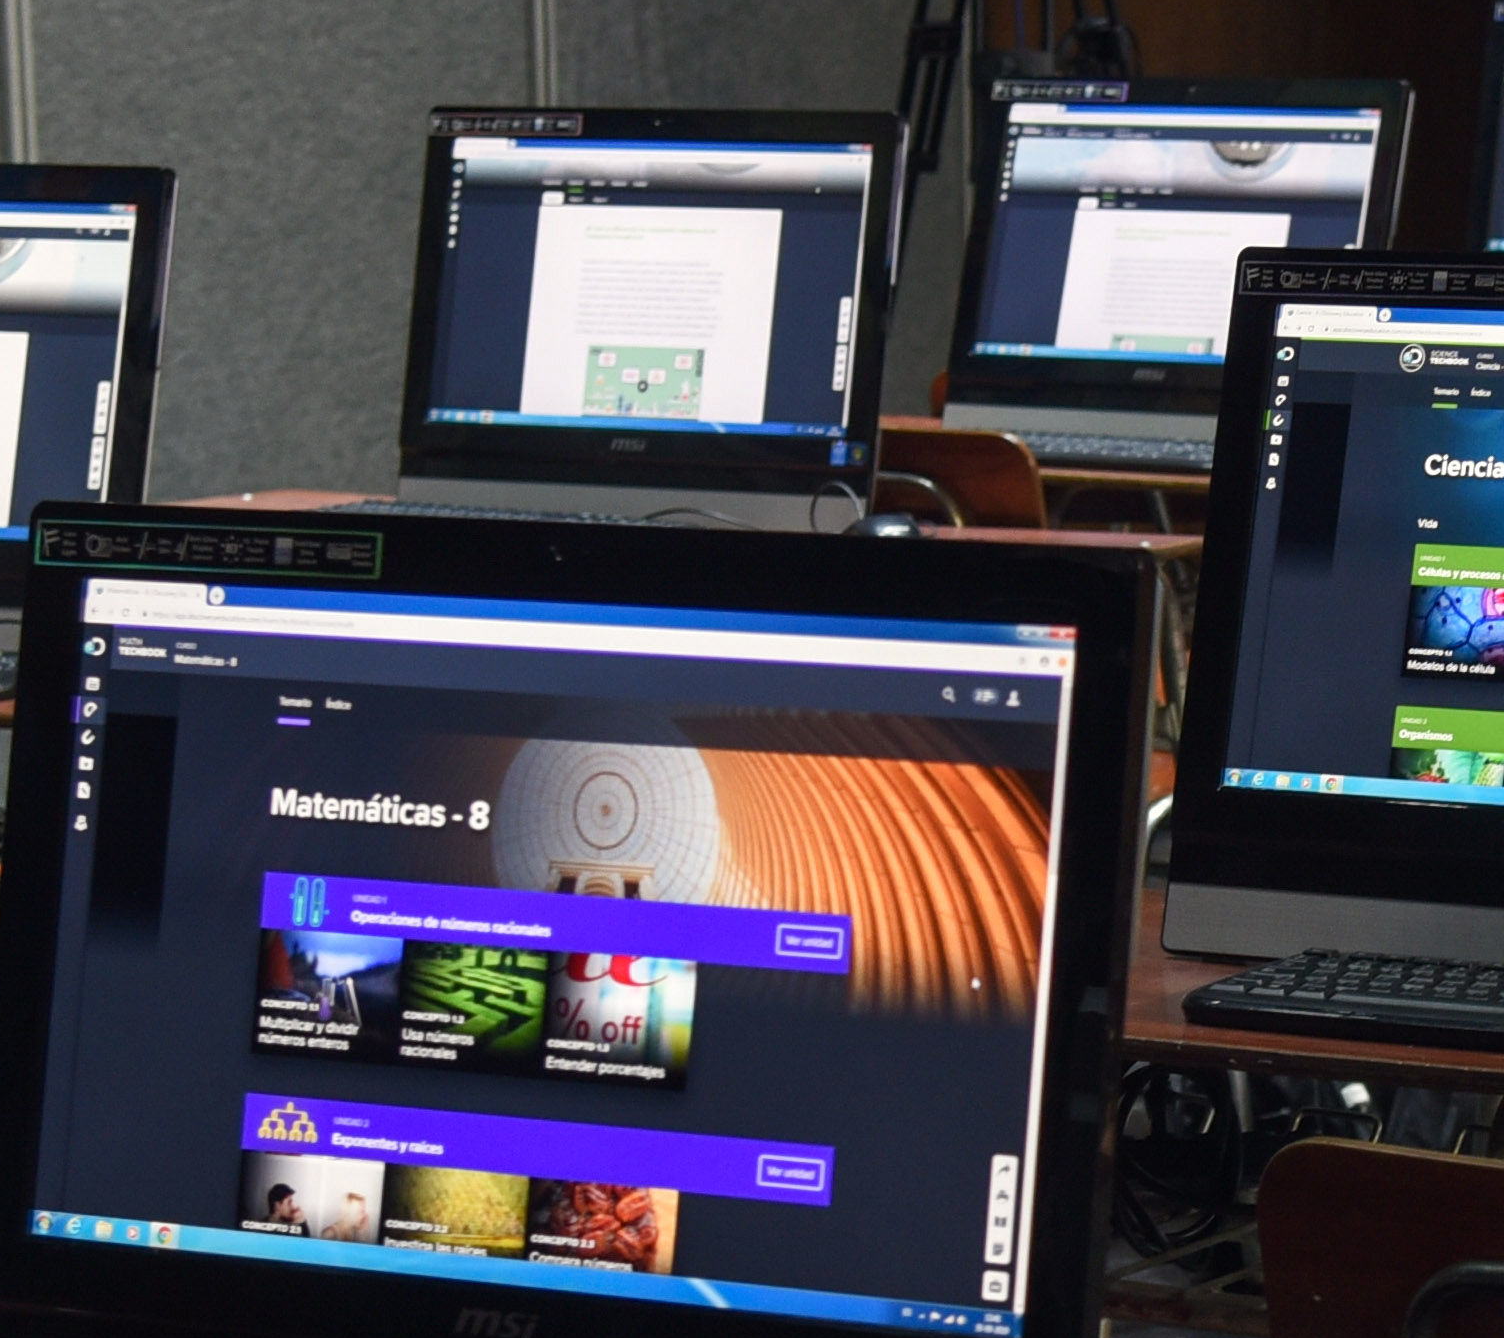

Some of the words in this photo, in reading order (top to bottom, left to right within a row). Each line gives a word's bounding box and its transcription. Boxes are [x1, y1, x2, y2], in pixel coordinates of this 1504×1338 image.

[1475, 362, 1500, 371] Ciencia
[1434, 386, 1460, 396] Temario
[1470, 386, 1491, 397] Índice
[1417, 518, 1438, 529] Vida
[1418, 565, 1451, 580] Células
[1452, 570, 1459, 581] y
[1460, 570, 1501, 582] procesos
[174, 652, 225, 667] Matemáticas
[1408, 648, 1442, 657] CONCEPTO
[1407, 660, 1445, 672] Modelos
[1446, 662, 1458, 673] de
[1459, 663, 1468, 673] la
[1469, 663, 1496, 675] célula
[279, 695, 313, 708] Temario
[325, 696, 352, 710] Índice
[1399, 729, 1453, 744] Organismos
[270, 786, 447, 828] Matemáticas
[468, 800, 490, 831] 8
[350, 909, 422, 929] Operaciones
[424, 915, 439, 929] de
[440, 916, 490, 932] números
[492, 920, 551, 938] racionales
[261, 998, 307, 1011] CONCEPTO
[403, 1010, 450, 1023] CONCEPTO
[259, 1015, 314, 1033] Multiplicar
[315, 1023, 323, 1035] y
[325, 1022, 360, 1037] dividir
[601, 1014, 642, 1045] off
[258, 1032, 305, 1047] números
[308, 1035, 349, 1050] enteros
[402, 1027, 423, 1042] Usa
[425, 1029, 474, 1047] números
[546, 1038, 596, 1052] CONCEPTO
[400, 1045, 457, 1061] racionales
[545, 1055, 597, 1074] Entender
[598, 1059, 665, 1080] porcentajes
[331, 1131, 397, 1152] Exponentes
[399, 1140, 408, 1155] y
[409, 1139, 443, 1156] raíces
[242, 1219, 288, 1233] CONCEPTO
[385, 1218, 431, 1232] CONCEPTO
[530, 1232, 577, 1248] CONCEPTO
[435, 1241, 453, 1255] las
[454, 1242, 487, 1258] raíces
